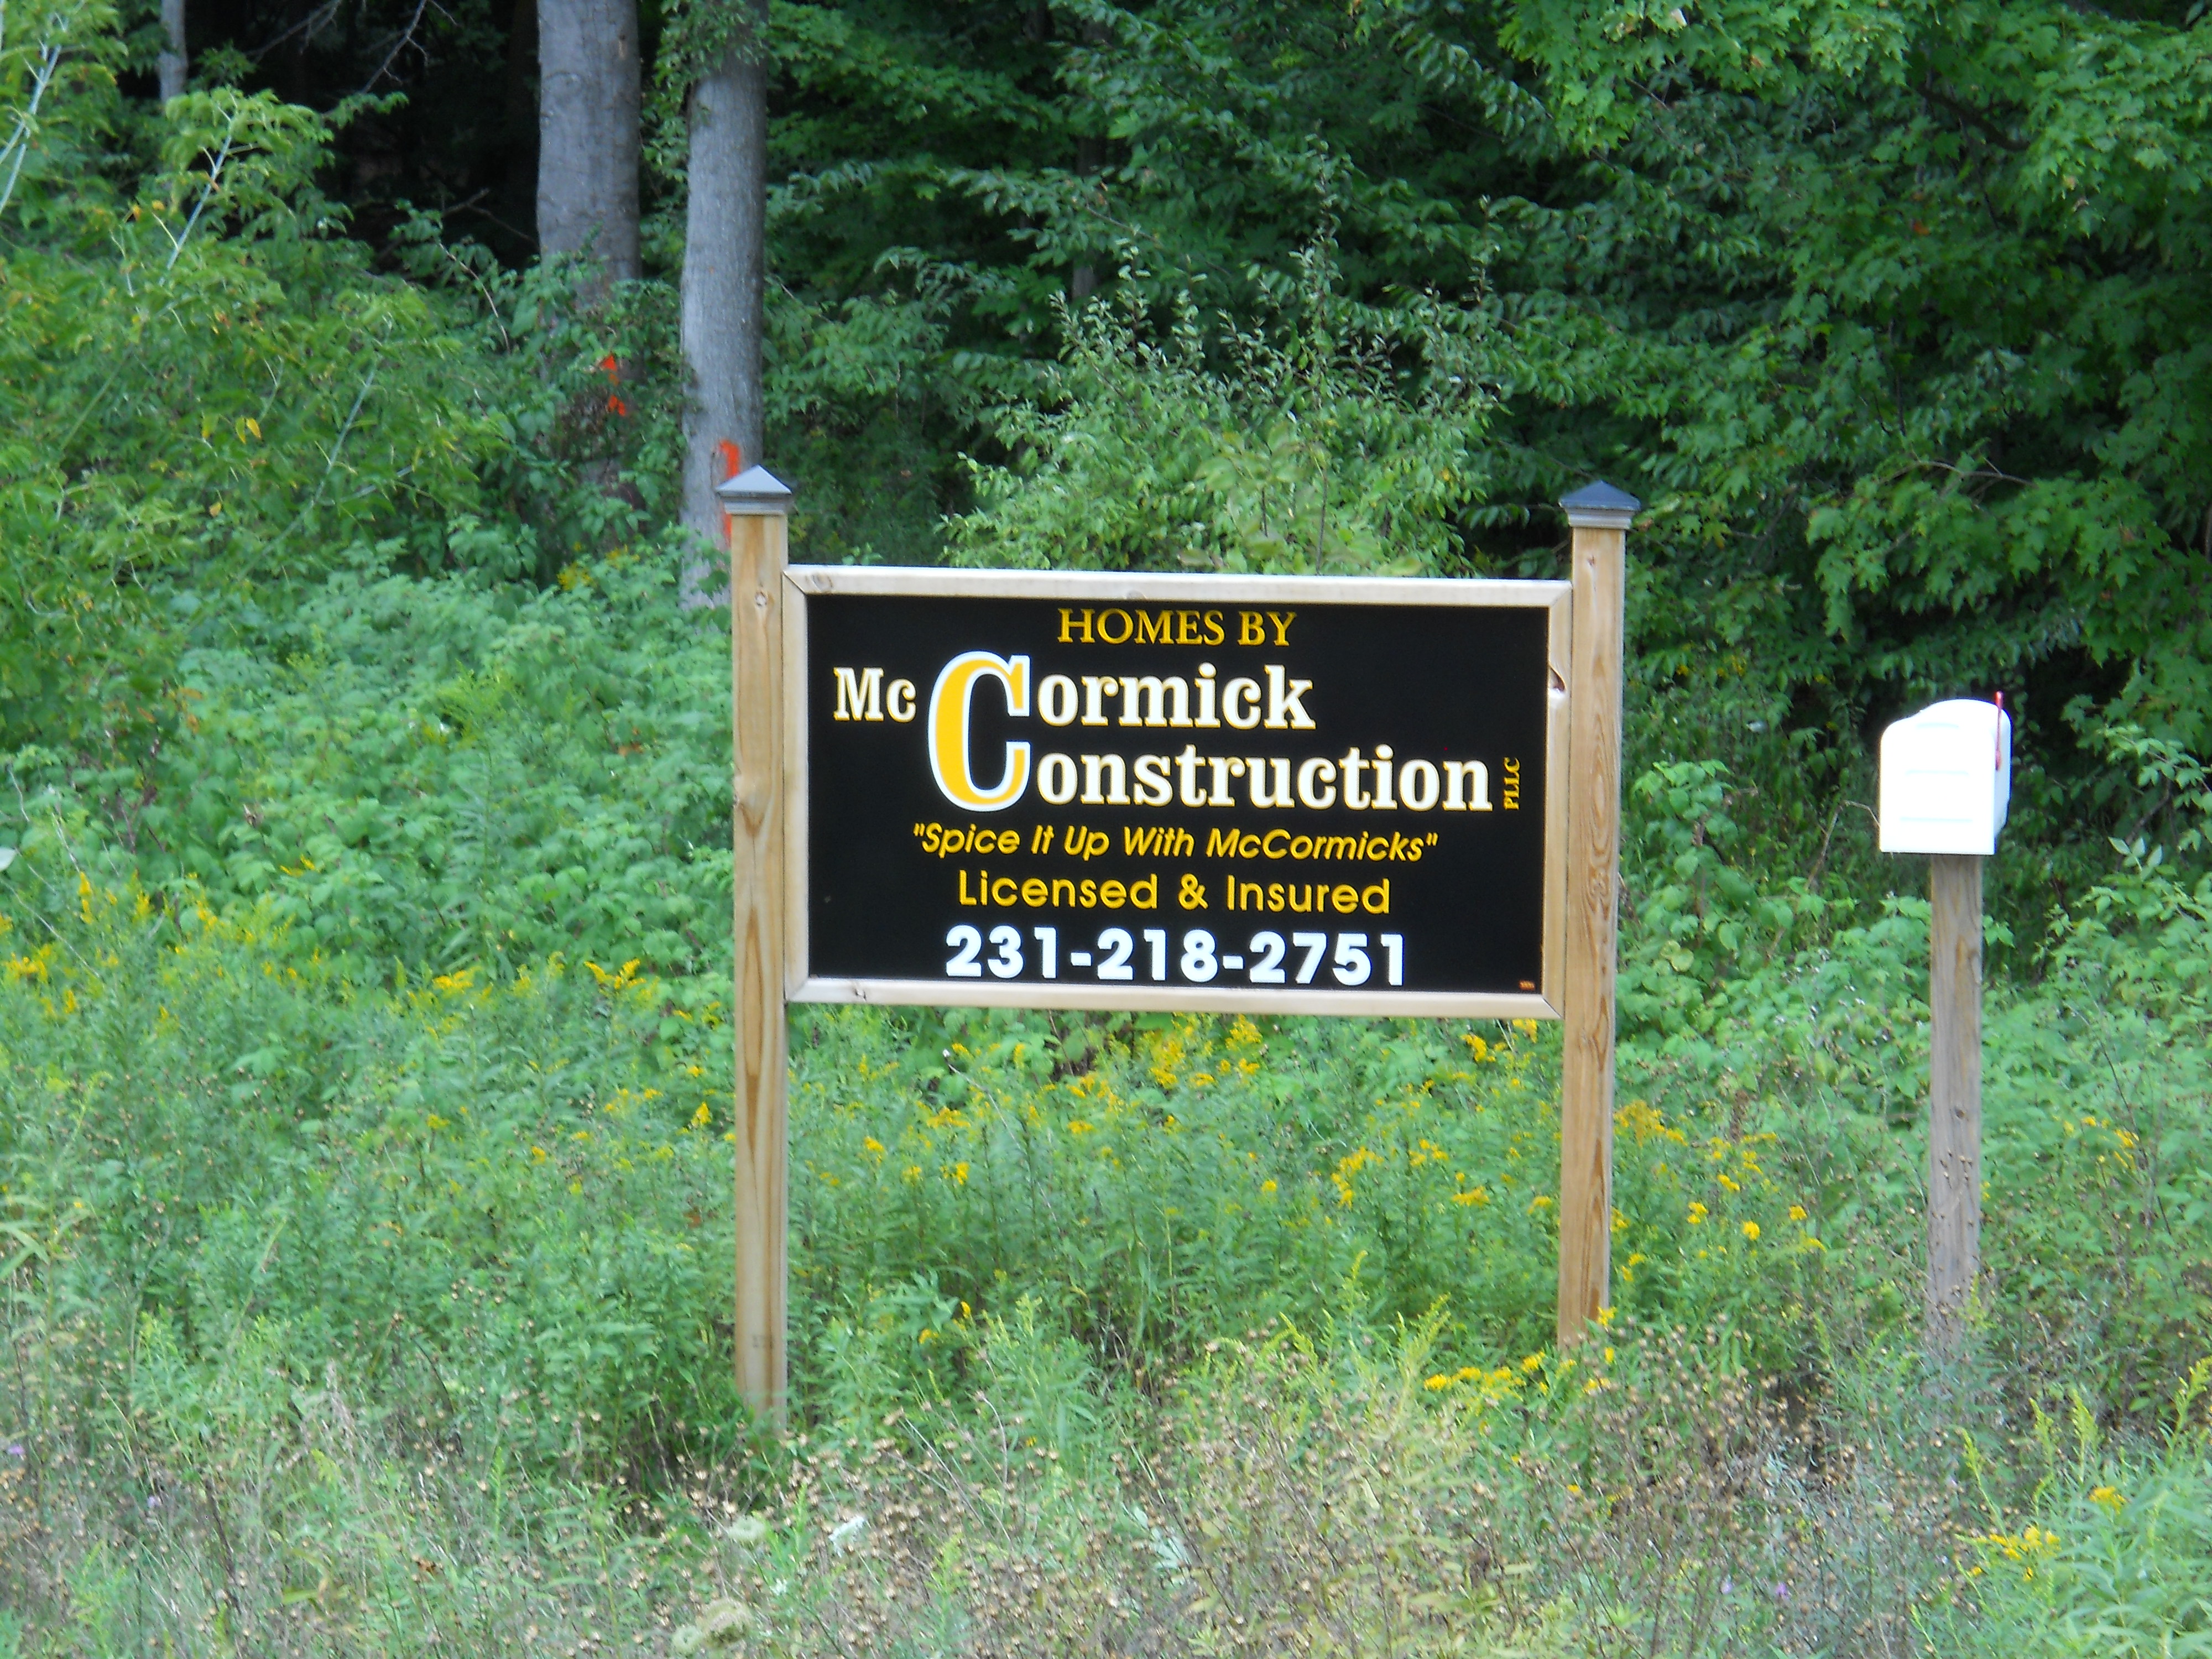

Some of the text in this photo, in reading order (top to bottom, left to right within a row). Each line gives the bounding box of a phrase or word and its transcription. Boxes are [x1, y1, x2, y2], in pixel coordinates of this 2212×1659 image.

[1057, 608, 1297, 646] HOMES BY
[1504, 757, 1520, 810] PLLC
[914, 822, 1438, 862] "Spice It Up With McCormicks"
[959, 870, 1391, 914] Licensed & Insured
[945, 925, 1405, 987] 231-218-2751
